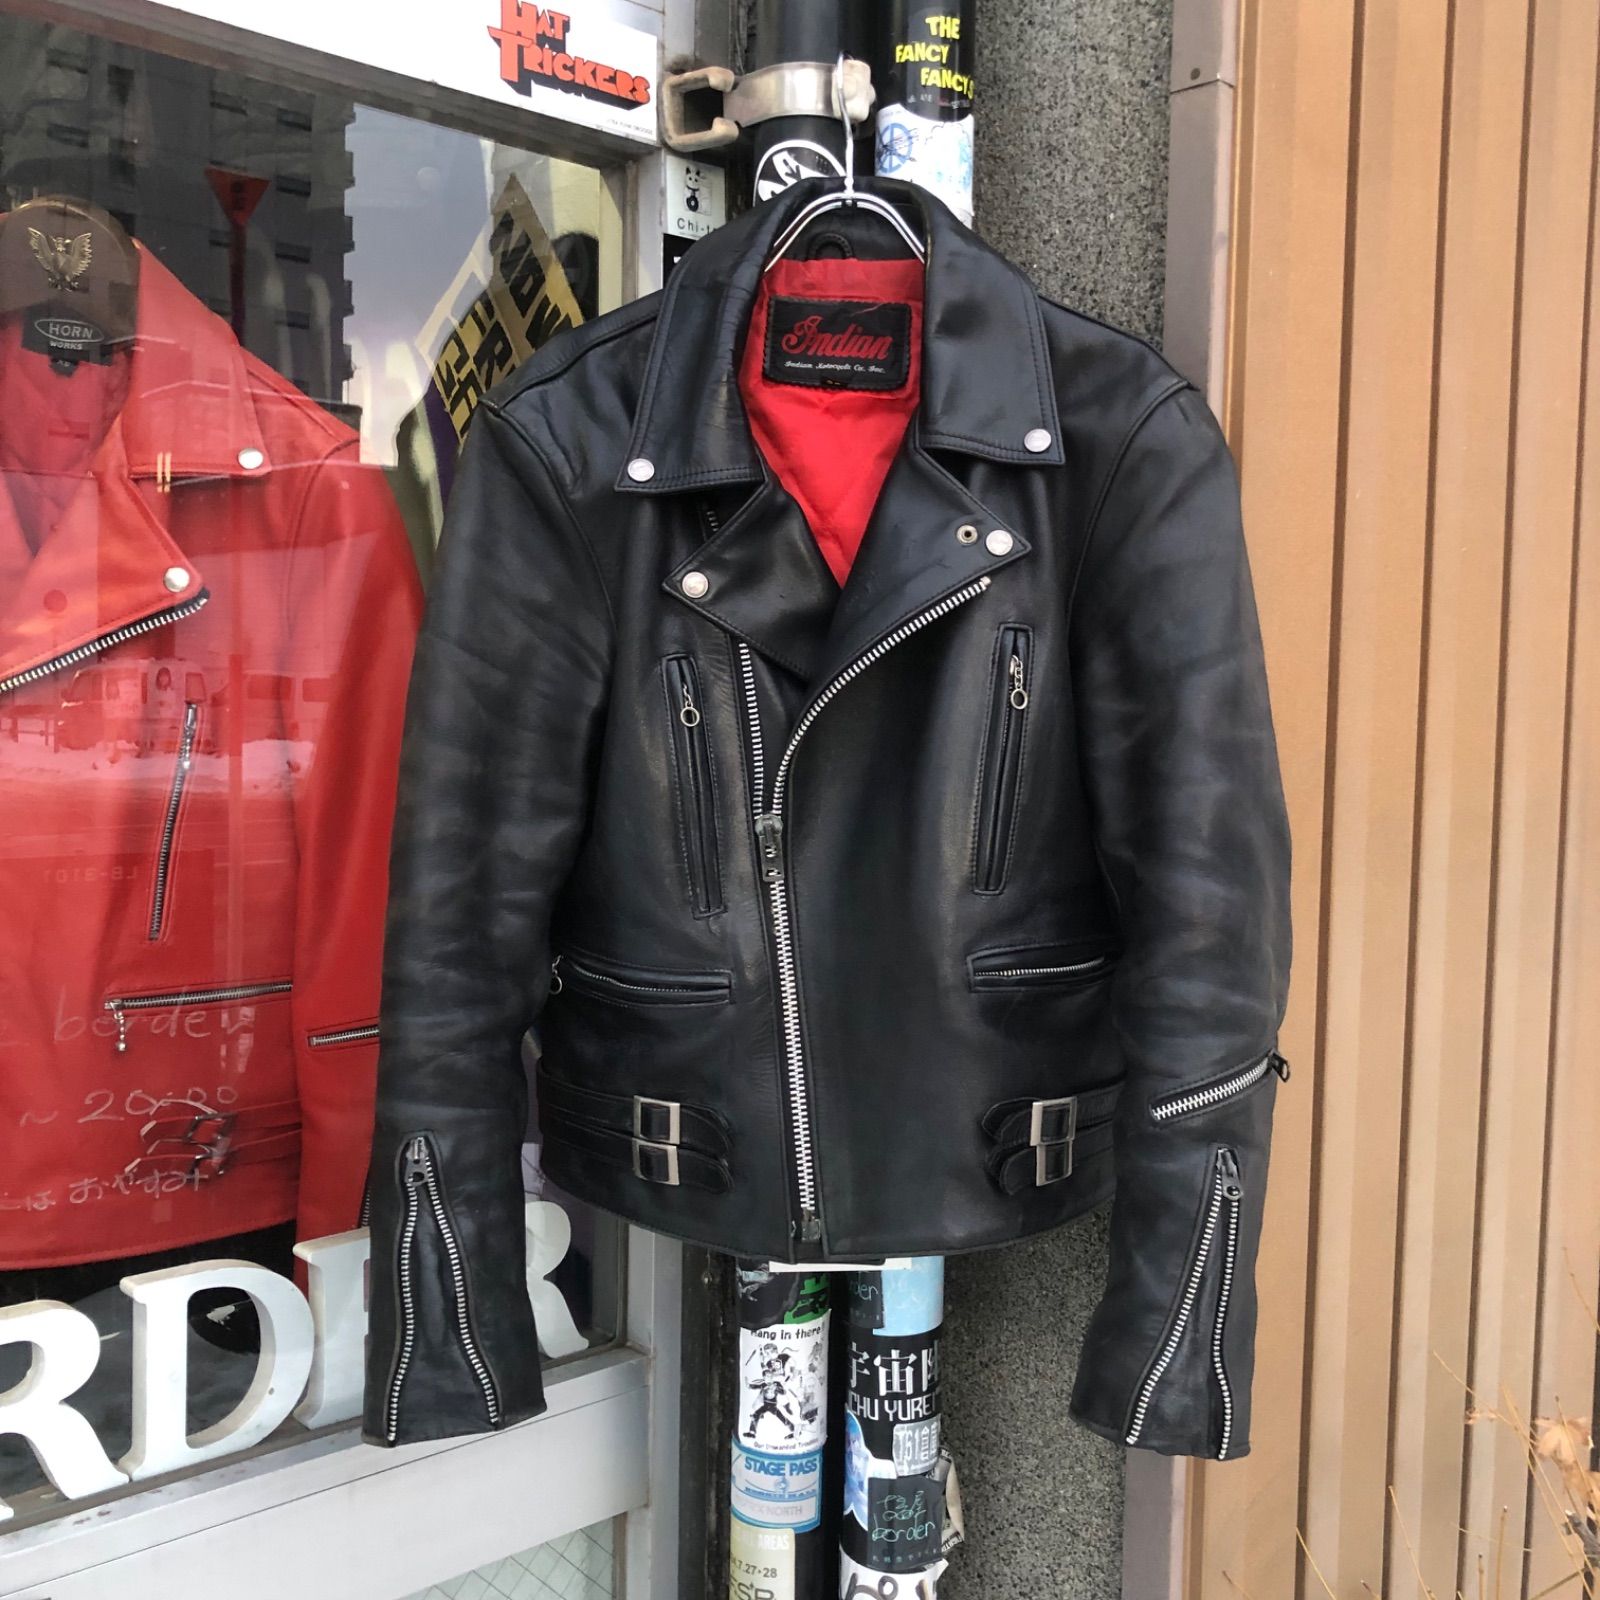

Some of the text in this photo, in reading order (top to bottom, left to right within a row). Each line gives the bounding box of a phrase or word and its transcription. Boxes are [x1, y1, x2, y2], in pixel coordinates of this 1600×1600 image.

[925, 16, 960, 39] THE
[896, 42, 950, 64] FANCY
[49, 322, 93, 340] HORN
[781, 315, 893, 360] Indian
[50, 340, 83, 350] WORKS
[781, 1330, 792, 1340] in
[745, 1456, 818, 1477] STAGE PASS
